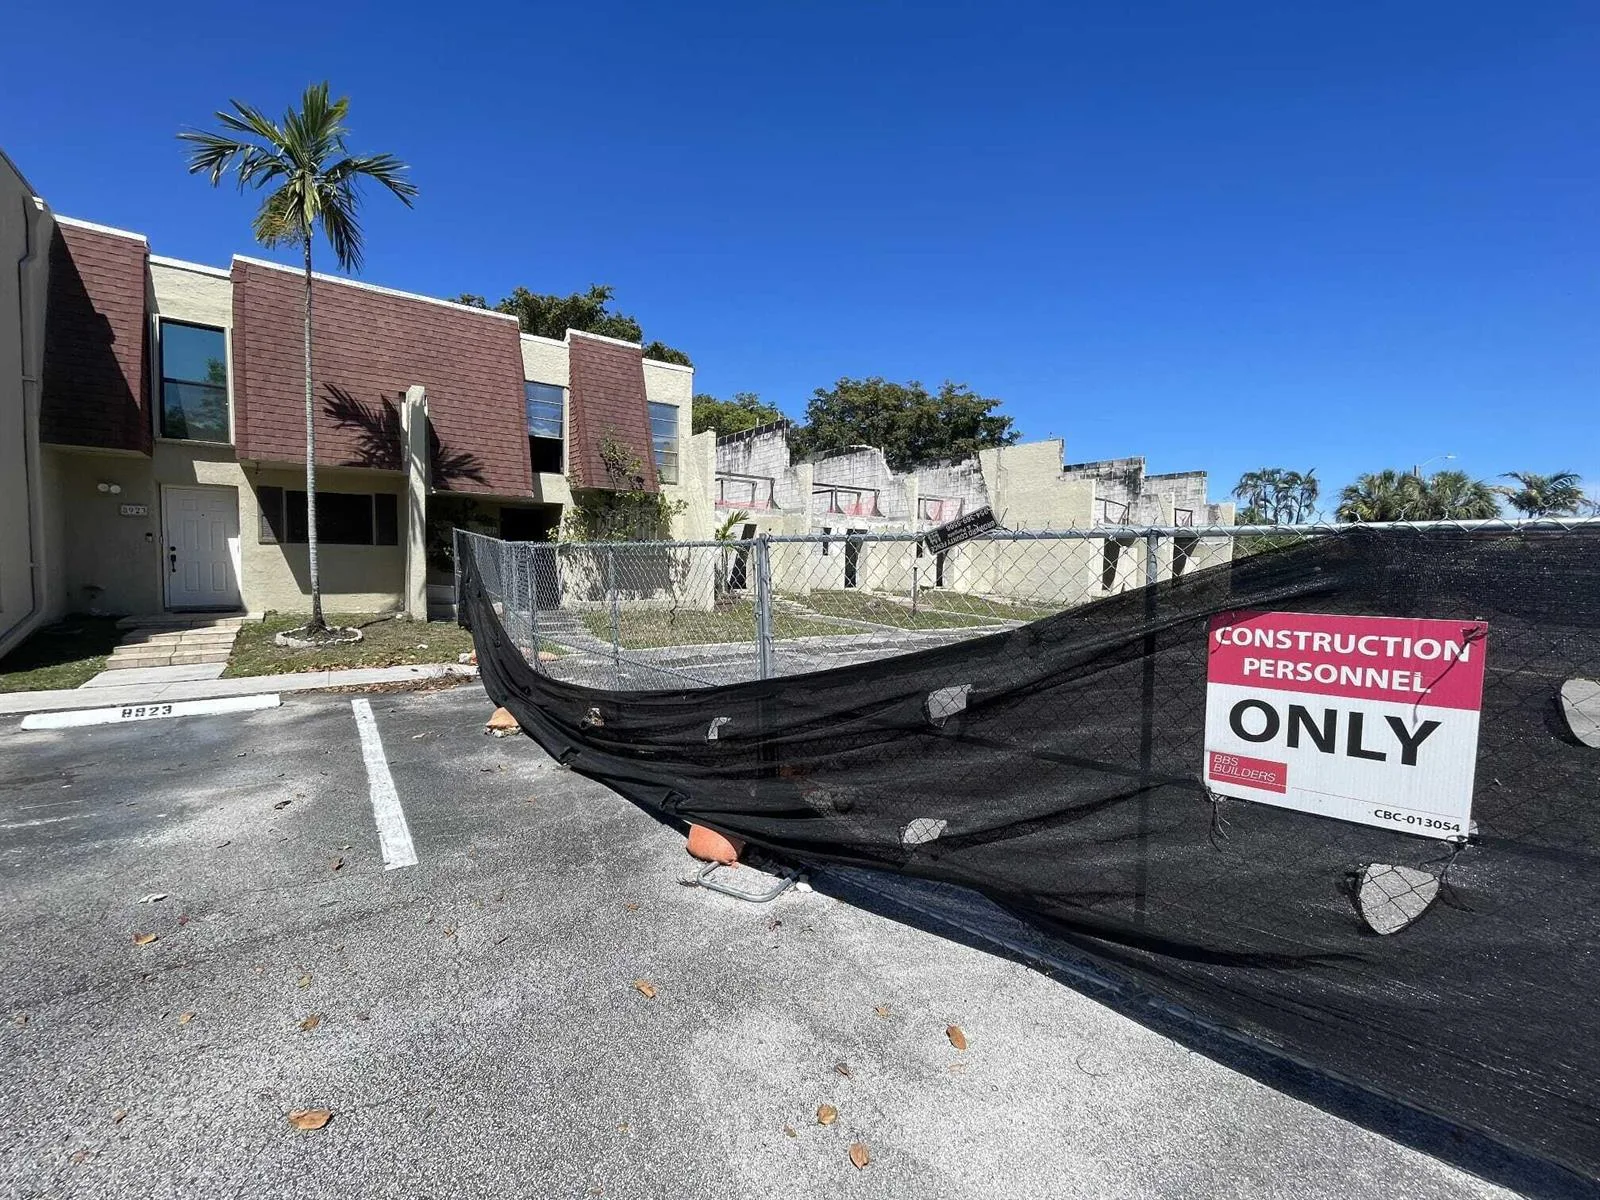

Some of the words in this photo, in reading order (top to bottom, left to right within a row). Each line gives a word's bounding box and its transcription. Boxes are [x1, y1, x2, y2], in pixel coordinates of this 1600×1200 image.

[930, 541, 947, 552] FENCE
[948, 532, 968, 545] COUNTY
[1215, 626, 1471, 663] CONSTRUCTION
[1243, 657, 1431, 693] PERSONNEL
[1229, 698, 1442, 767] ONLY
[1213, 754, 1239, 767] BBS
[1213, 763, 1276, 782] BUILDERS
[1374, 809, 1461, 832] CBC-013054
